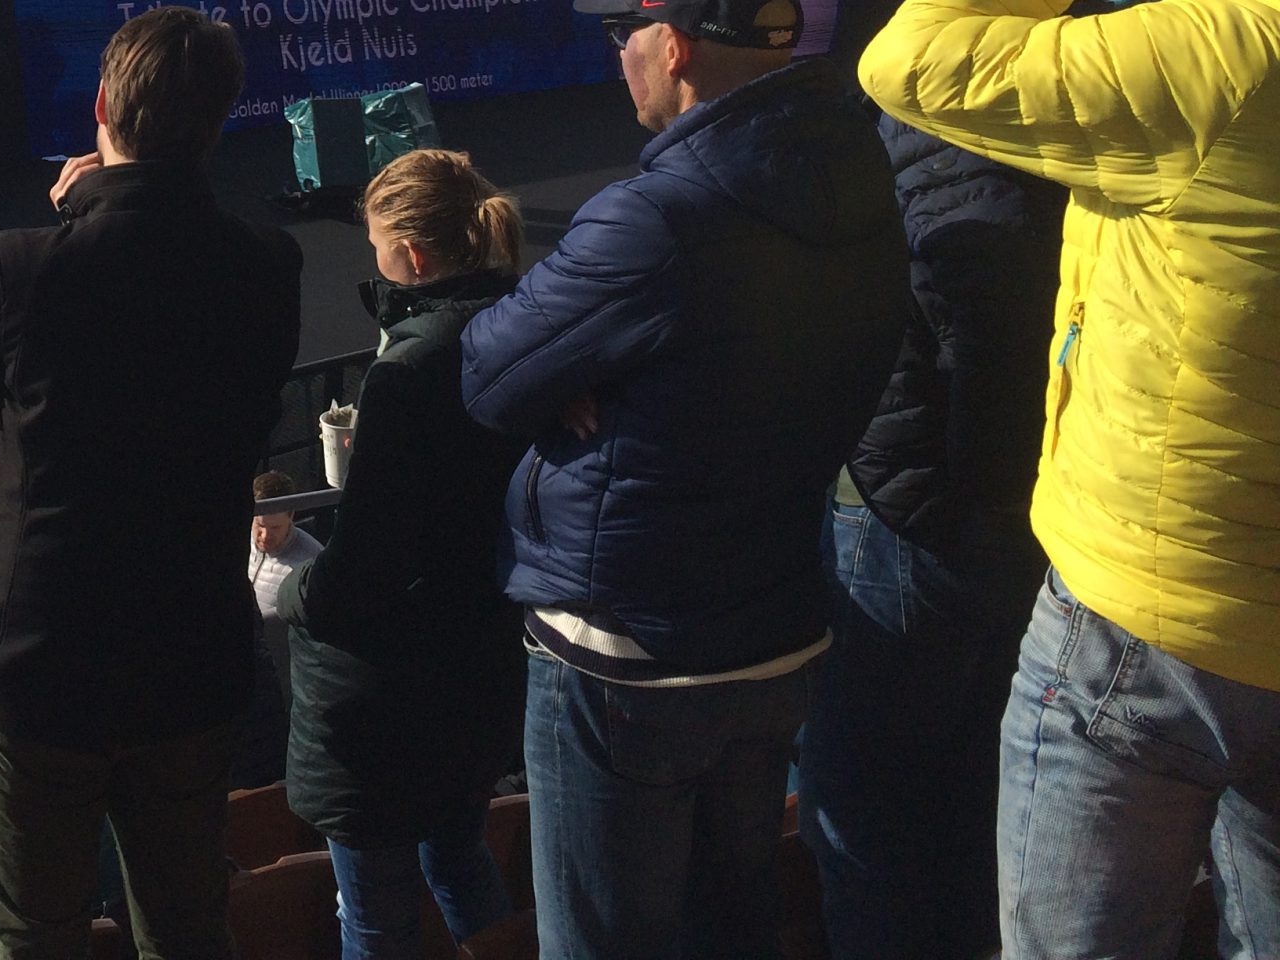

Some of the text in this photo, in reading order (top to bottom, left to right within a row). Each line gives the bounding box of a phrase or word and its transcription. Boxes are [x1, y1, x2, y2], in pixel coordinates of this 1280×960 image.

[280, 26, 417, 72] Kjeld Nuis
[425, 74, 456, 92] 1500
[460, 72, 493, 87] meter
